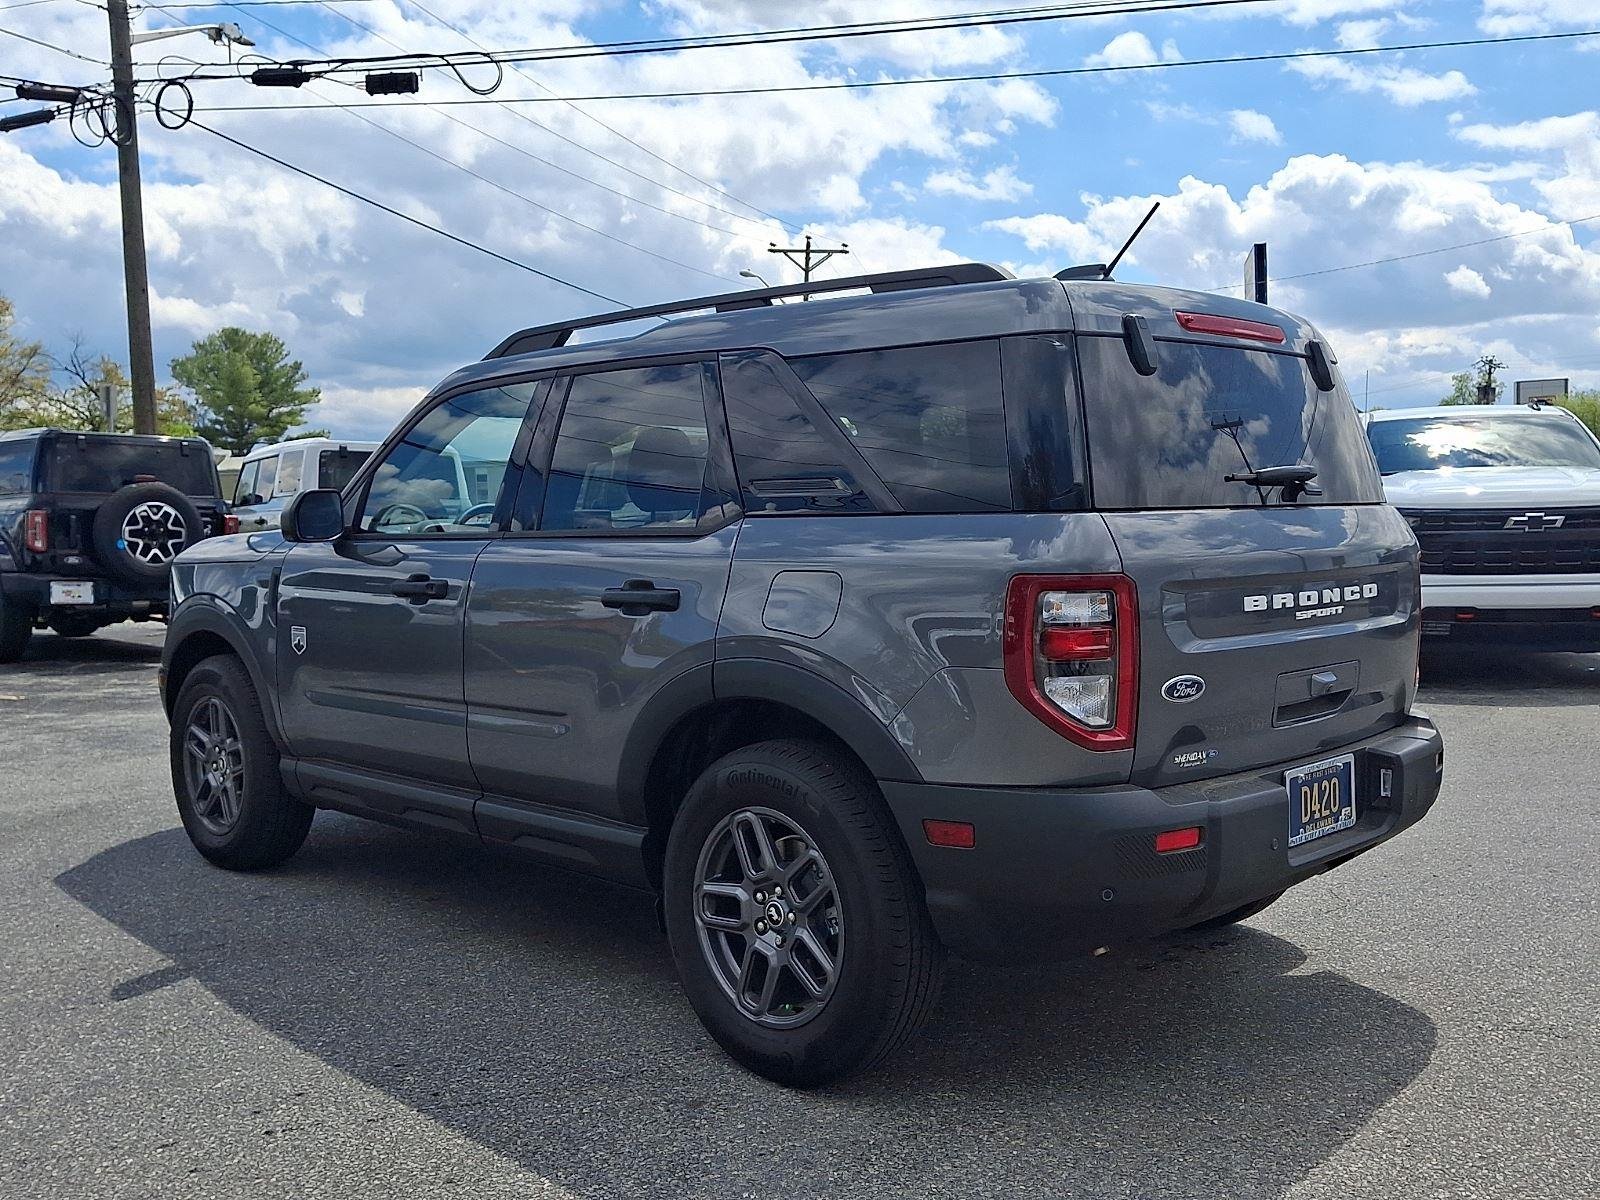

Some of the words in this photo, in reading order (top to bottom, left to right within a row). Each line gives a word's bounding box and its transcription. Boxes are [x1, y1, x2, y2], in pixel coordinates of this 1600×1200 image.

[1243, 583, 1378, 612] BRONCO
[1296, 606, 1345, 620] SPORT
[1173, 680, 1198, 697] Ford
[727, 768, 800, 797] Continental
[1301, 777, 1339, 824] D420
[1305, 816, 1335, 833] DELAWARE
